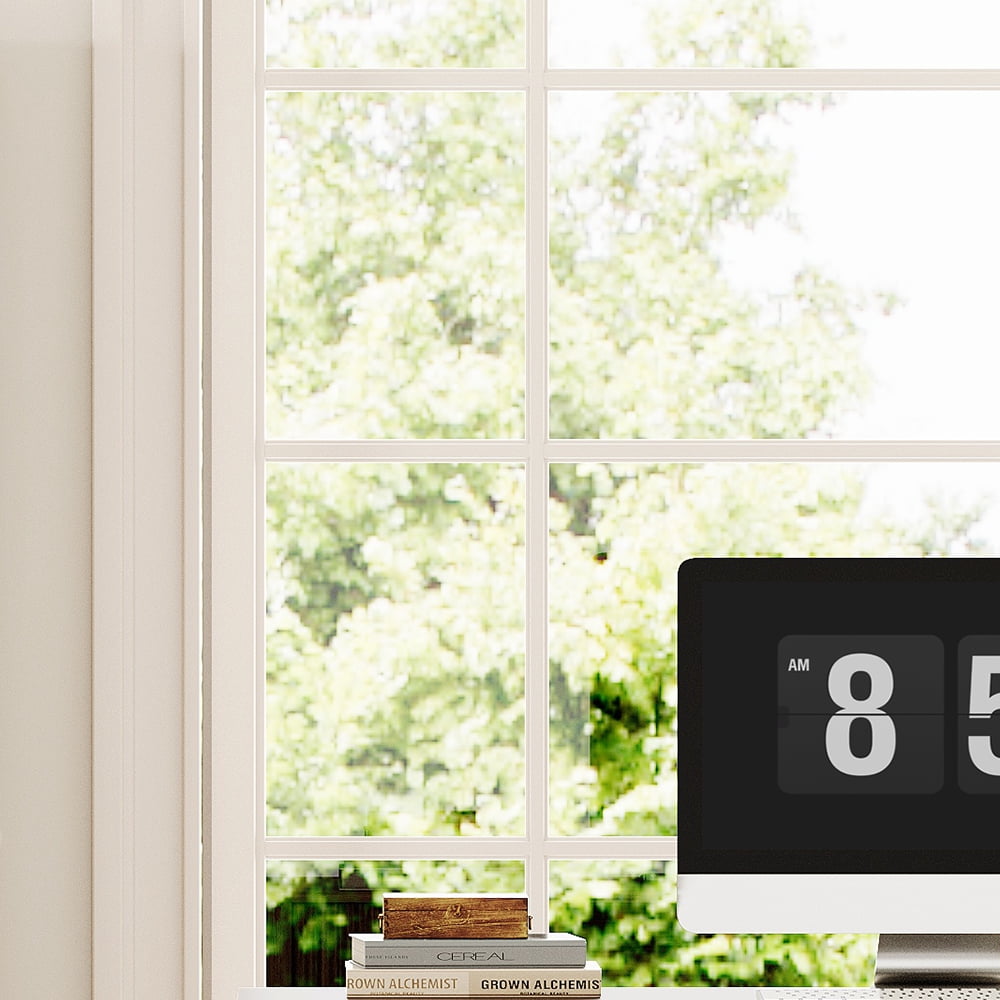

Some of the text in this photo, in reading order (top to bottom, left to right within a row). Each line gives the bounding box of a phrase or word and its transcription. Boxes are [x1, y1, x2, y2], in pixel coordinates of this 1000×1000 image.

[788, 658, 810, 671] AM
[825, 653, 897, 776] 8
[436, 952, 515, 961] CEREAL
[389, 978, 458, 989] ALCHEMIST
[481, 979, 602, 990] GROWN ALCHEMIS
